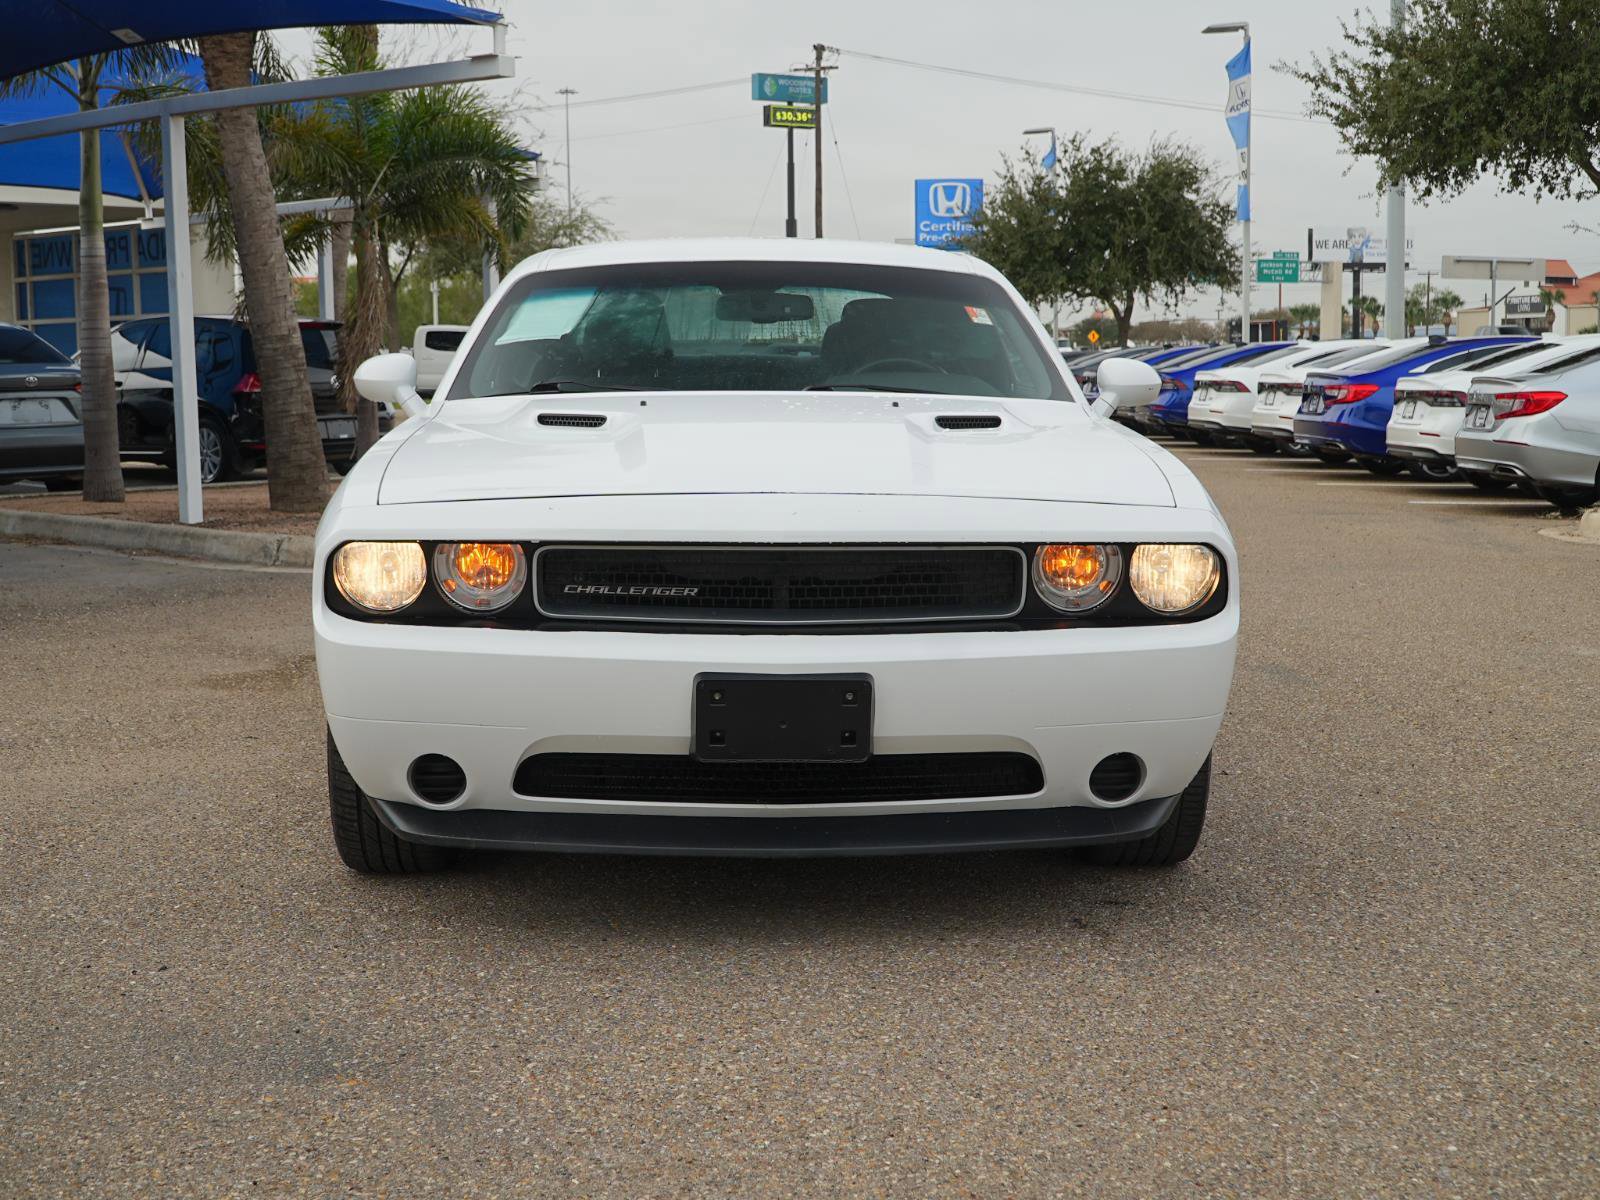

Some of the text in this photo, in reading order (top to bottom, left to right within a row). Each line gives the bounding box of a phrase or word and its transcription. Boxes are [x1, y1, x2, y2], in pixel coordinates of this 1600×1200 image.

[1315, 239, 1350, 249] WE ARE
[563, 585, 699, 596] CHALLENGER
